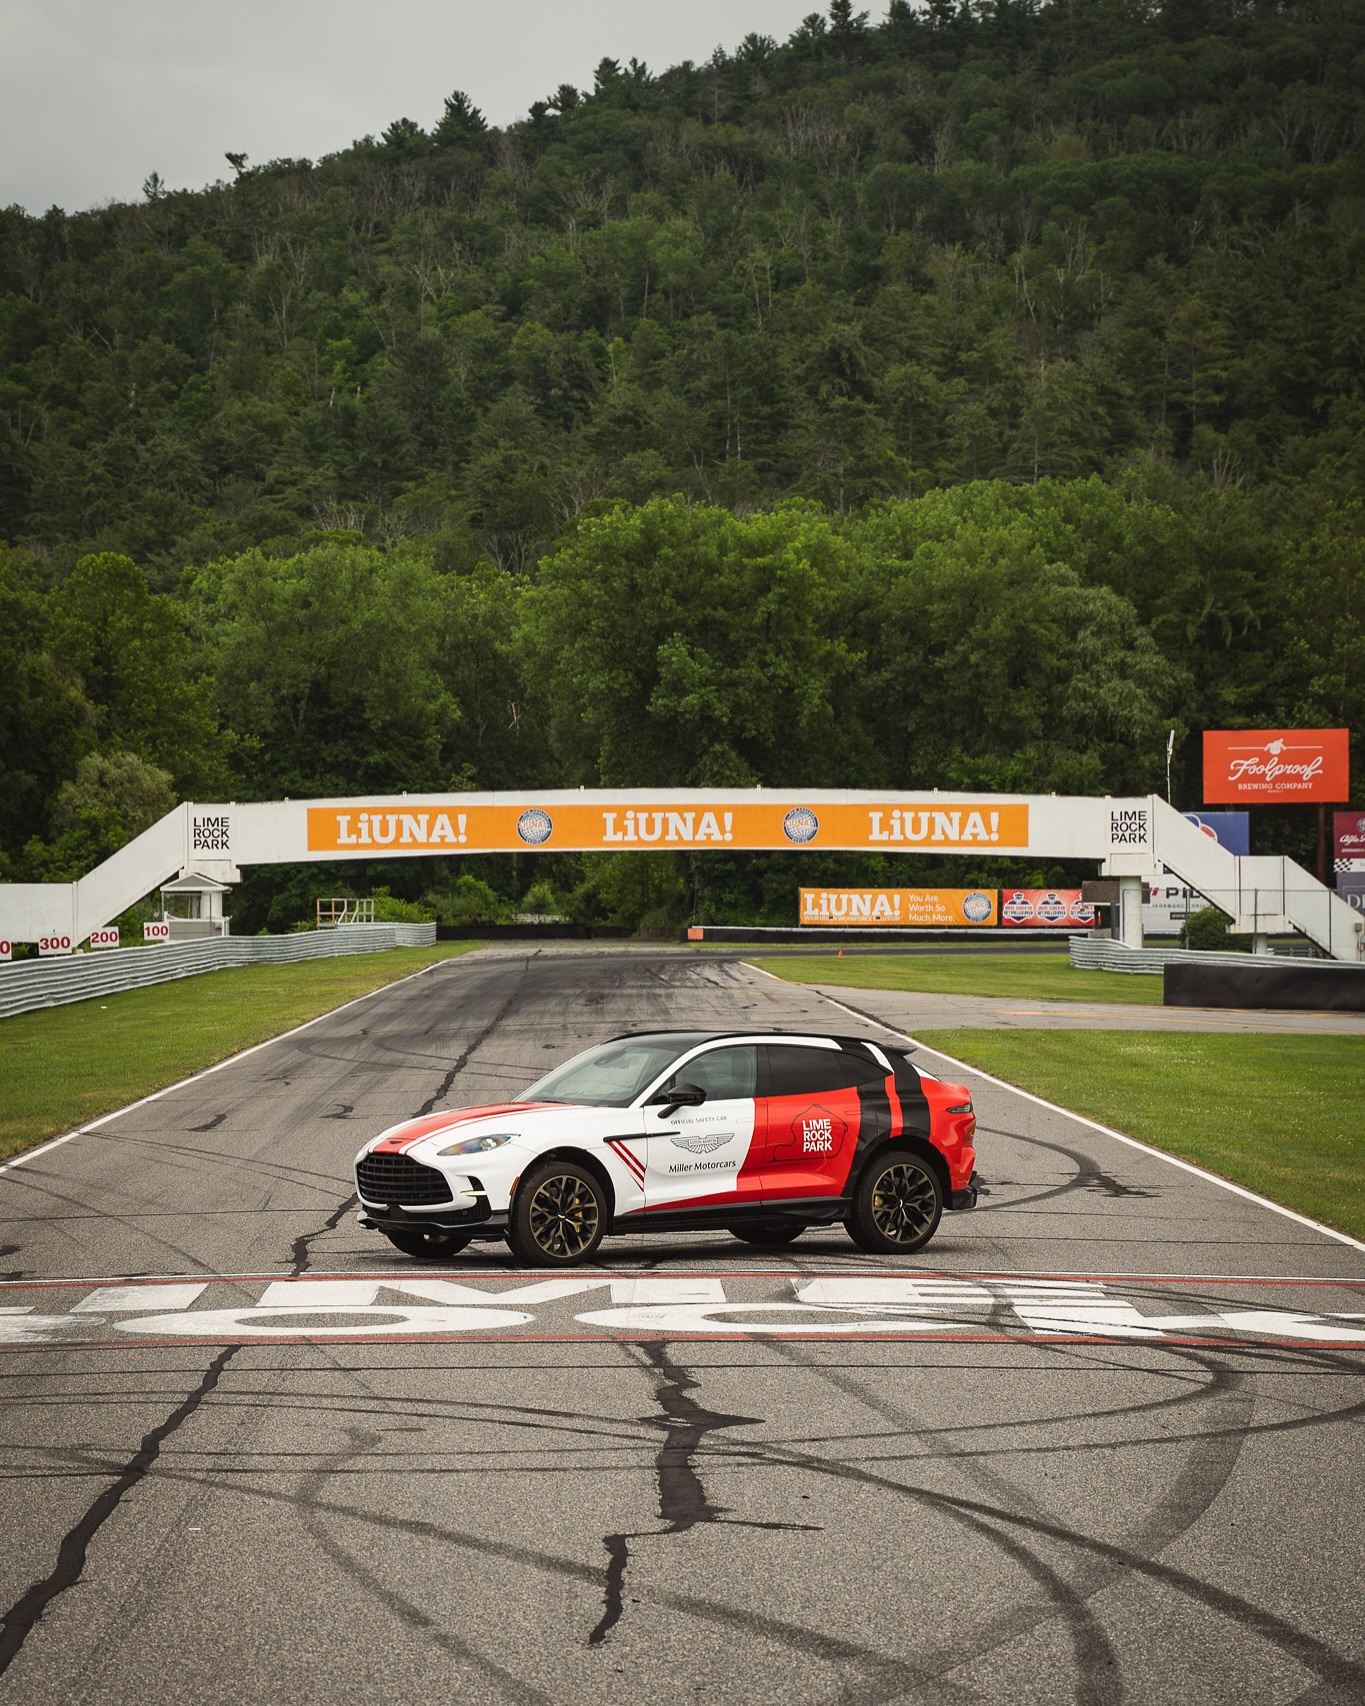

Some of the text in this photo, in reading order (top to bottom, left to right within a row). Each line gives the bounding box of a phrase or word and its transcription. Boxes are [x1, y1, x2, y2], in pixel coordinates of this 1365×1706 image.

[1227, 755, 1323, 781] Foolproof
[1238, 782, 1272, 790] BREWING
[193, 816, 230, 828] LIME
[1110, 810, 1147, 822] LIME
[336, 812, 468, 844] LiUNA!
[602, 810, 735, 842] LiUNA!
[868, 810, 1000, 842] LiUNA!
[1110, 821, 1147, 833] ROCK
[193, 827, 230, 839] ROCK
[1110, 832, 1148, 844] PARK
[193, 838, 230, 850] PARK
[803, 892, 901, 916] LiUNA!
[908, 894, 938, 902] You Are
[908, 904, 945, 912] Worth So
[908, 914, 955, 922] Much More.
[91, 931, 119, 943] 200
[144, 925, 169, 937] 100
[39, 936, 71, 950] 300
[802, 1118, 831, 1131] LIME
[803, 1128, 833, 1142] ROCK
[803, 1140, 833, 1153] PARK
[668, 1159, 736, 1173] Miller Motorcars
[0, 1278, 1137, 1314] IME
